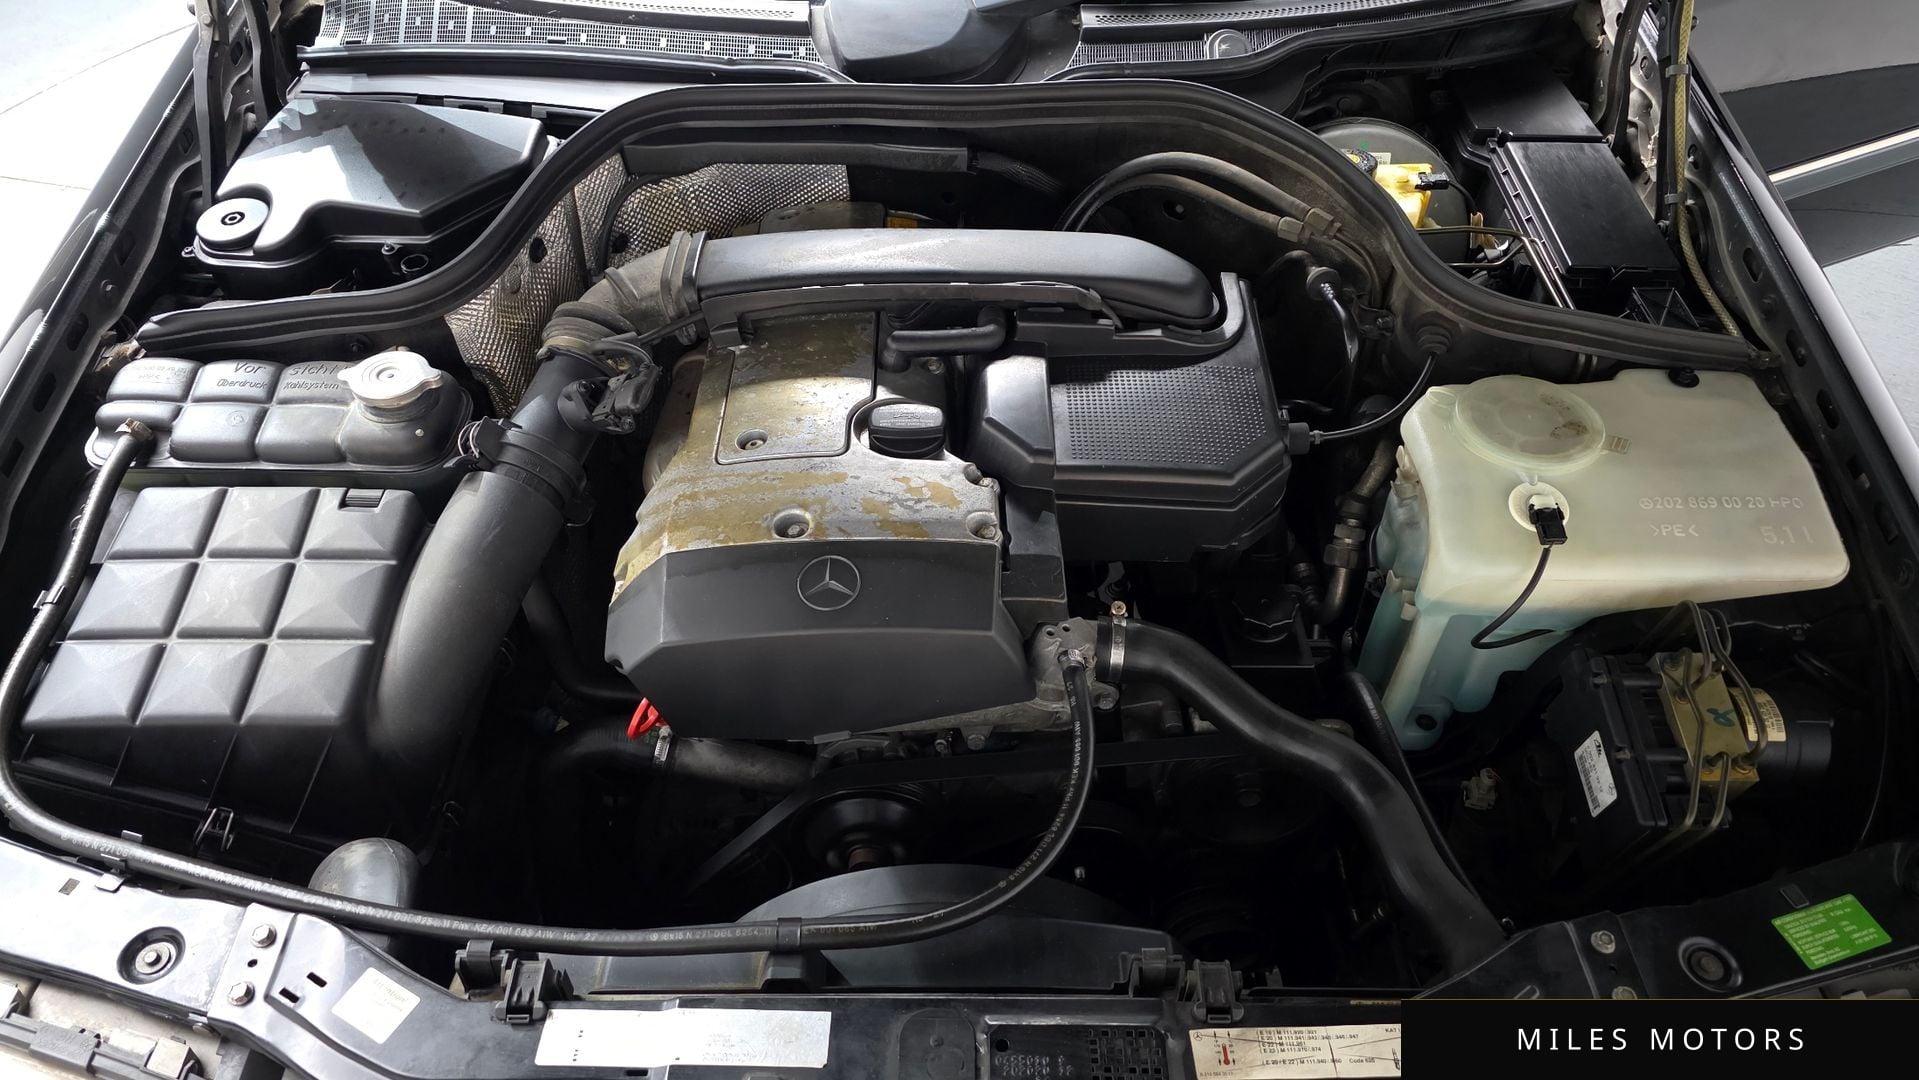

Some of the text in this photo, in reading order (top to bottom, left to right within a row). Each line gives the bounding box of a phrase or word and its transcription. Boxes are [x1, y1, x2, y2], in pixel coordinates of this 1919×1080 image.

[1655, 497, 1684, 509] 202
[1687, 497, 1718, 509] 869
[1721, 497, 1742, 509] 00
[1745, 497, 1766, 509] 20
